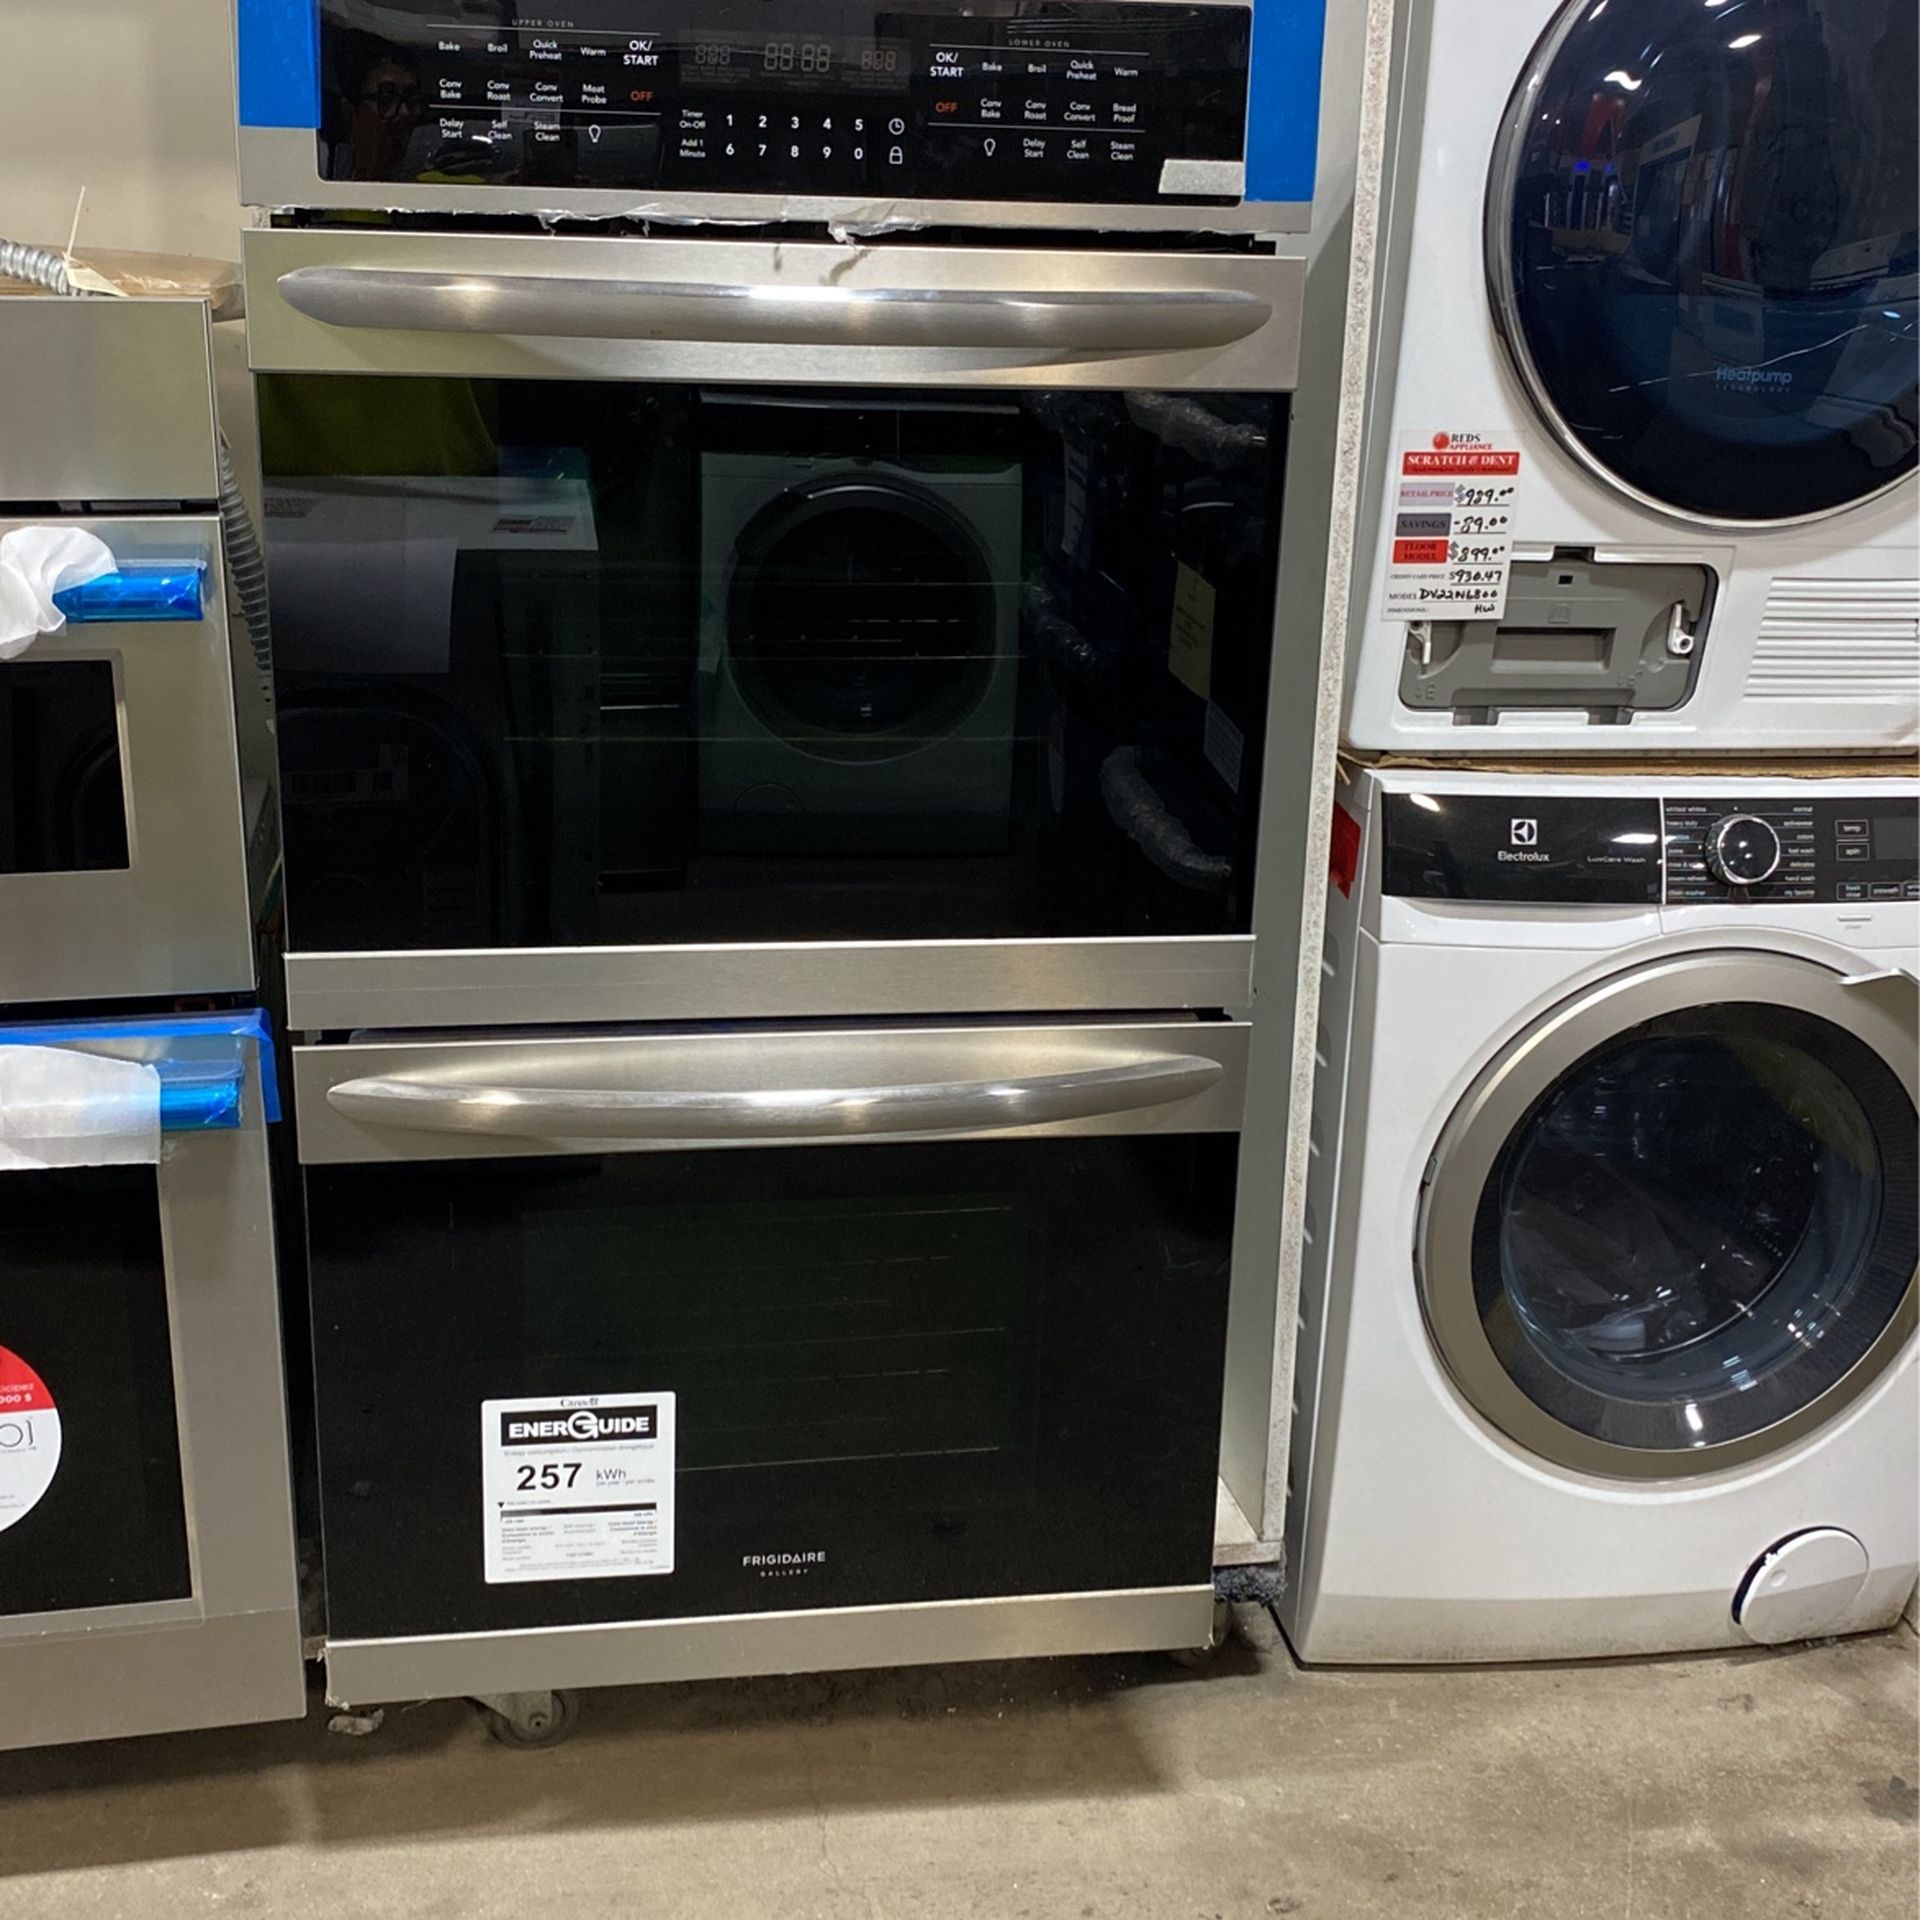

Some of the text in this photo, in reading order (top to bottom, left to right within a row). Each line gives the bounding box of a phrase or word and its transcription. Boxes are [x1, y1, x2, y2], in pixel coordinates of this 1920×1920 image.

[512, 19, 574, 29] UPPER OVEN
[438, 41, 460, 51] Bake
[487, 43, 508, 53] Broil
[533, 39, 558, 50] Quick
[629, 40, 653, 51] OK/
[1009, 38, 1070, 48] LOWER OVEN
[529, 50, 562, 61] Preheat
[580, 47, 606, 56] Warm
[623, 55, 659, 66] START
[935, 52, 959, 63] OK/
[982, 62, 1003, 72] Bake
[1027, 63, 1047, 74] Broil
[1070, 60, 1094, 71] Quick
[930, 66, 965, 78] START
[1066, 70, 1097, 81] Preheat
[1114, 68, 1139, 77] Warm
[439, 78, 462, 88] Conv
[487, 80, 510, 90] Conv
[535, 82, 558, 92] Conv
[582, 83, 605, 93] Meat
[440, 89, 462, 99] Bake
[487, 91, 511, 101] Roast
[529, 92, 564, 103] Convert
[581, 93, 607, 104] Probe
[630, 91, 653, 101] OFF
[935, 102, 959, 113] OFF
[980, 98, 1002, 108] Conv
[1025, 100, 1047, 110] Conv
[1070, 101, 1091, 111] Conv
[1112, 103, 1137, 113] Bread
[682, 109, 704, 118] Timer
[981, 109, 1001, 119] Bake
[1024, 111, 1047, 121] Roast
[1063, 112, 1096, 122] Convert
[1113, 113, 1136, 124] Proof
[439, 118, 464, 130] Delay
[491, 119, 508, 129] Self
[534, 121, 561, 130] Steam
[679, 119, 706, 129] On-Off
[726, 114, 734, 127] 1
[758, 115, 767, 128] 2
[791, 116, 800, 129] 3
[822, 118, 832, 130] 4
[854, 118, 863, 131] 5
[441, 128, 463, 139] Start
[488, 130, 513, 140] Clean
[535, 131, 560, 142] Clean
[681, 138, 698, 147] Add
[1023, 138, 1046, 150] Delay
[1071, 139, 1087, 149] Self
[1110, 141, 1135, 150] Steam
[679, 148, 706, 158] Minute
[726, 143, 735, 156] 6
[758, 144, 767, 157] 7
[791, 145, 799, 158] 8
[822, 146, 832, 159] 9
[854, 147, 863, 160] 0
[1024, 149, 1044, 159] Start
[1067, 150, 1090, 160] Clean
[1110, 151, 1134, 161] Clean
[1716, 367, 1792, 385] Heatpump
[1451, 433, 1481, 443] REDS
[1408, 454, 1466, 465] SCRATCH
[1481, 454, 1516, 466] DENT
[1430, 490, 1453, 498] PRICE
[1401, 520, 1446, 529] SAVINGS
[1405, 543, 1437, 551] FLOOR
[1497, 851, 1549, 862] Electrolux
[24, 1392, 32, 1403] $
[517, 1463, 582, 1491] 257
[596, 1469, 626, 1480] kWh
[743, 1551, 826, 1567] FRIGIDAIRE
